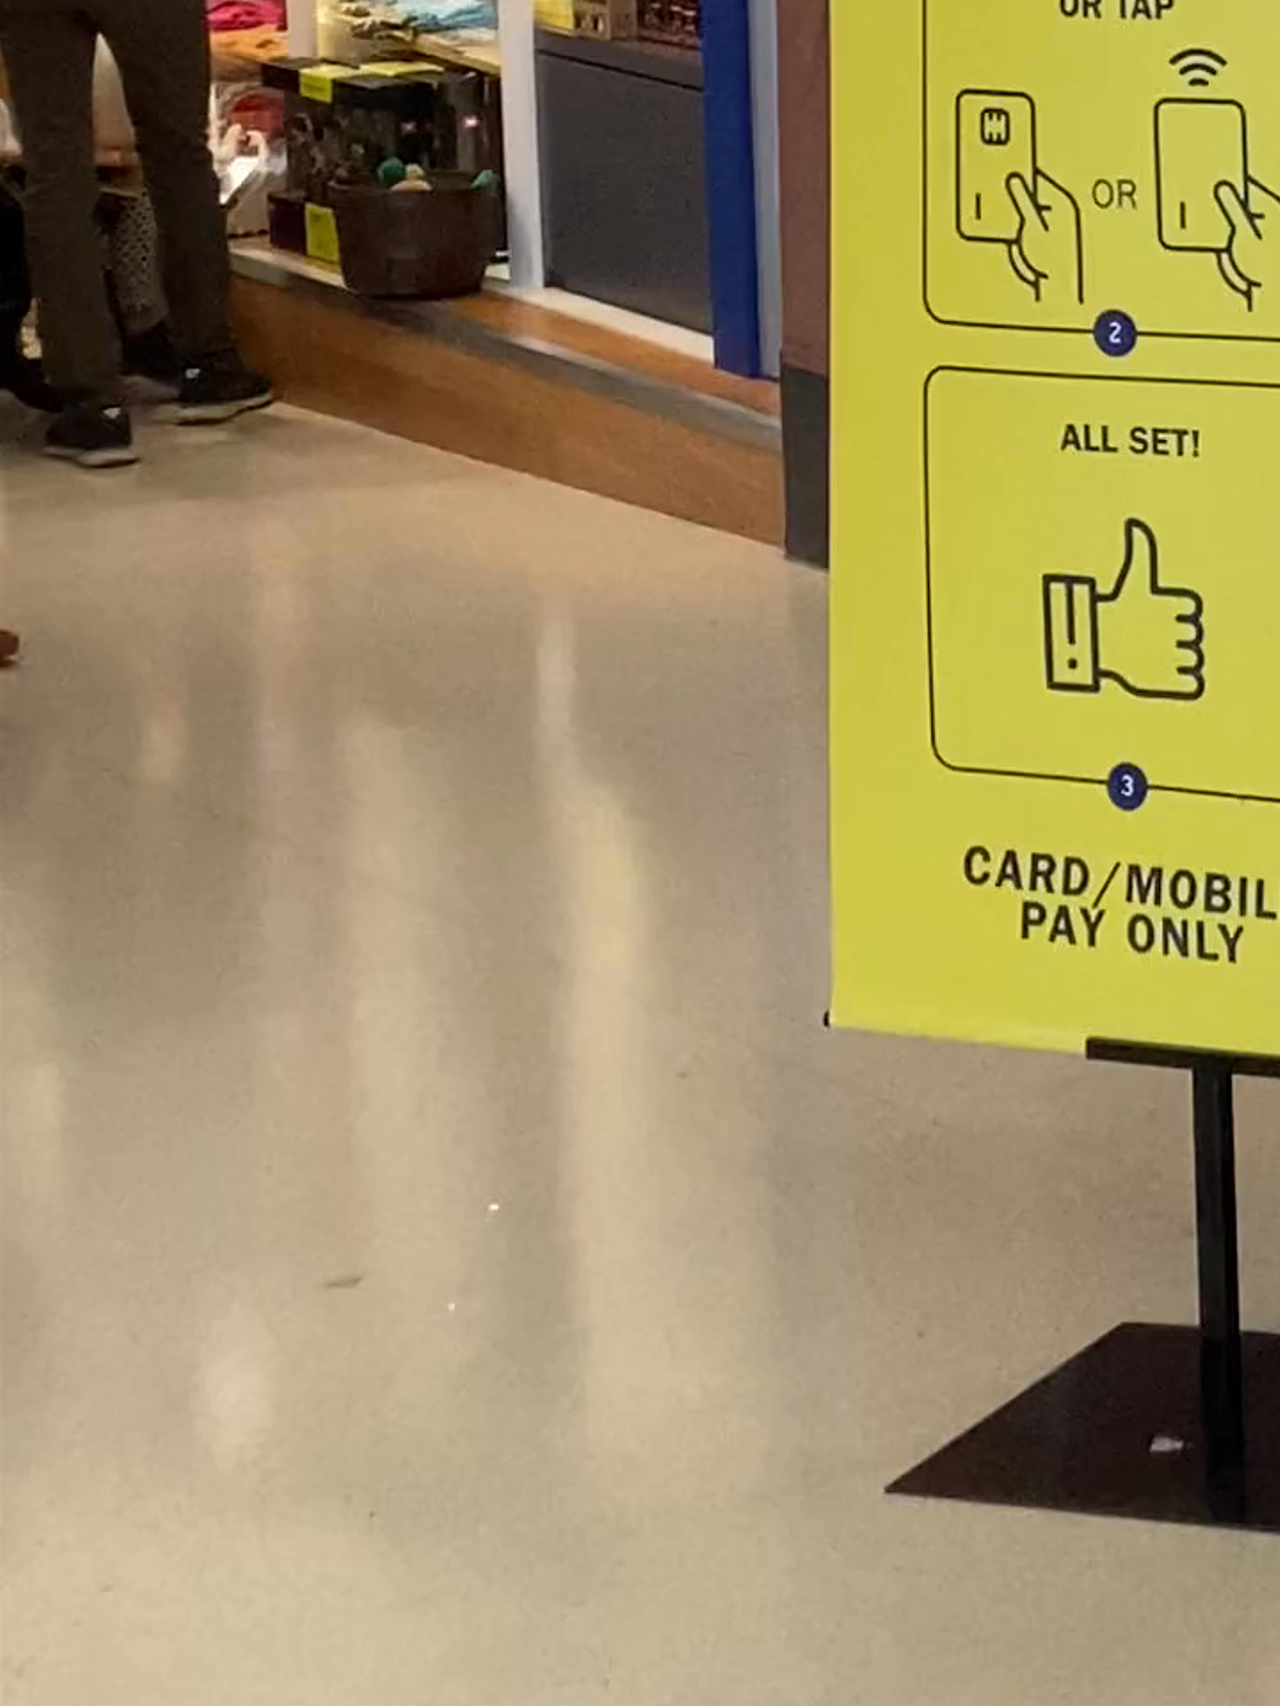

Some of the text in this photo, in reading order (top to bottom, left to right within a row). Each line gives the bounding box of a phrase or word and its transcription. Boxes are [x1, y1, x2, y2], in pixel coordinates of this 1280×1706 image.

[1091, 178, 1137, 211] OR
[1109, 321, 1122, 344] 2
[1060, 423, 1201, 458] ALL SET!
[1121, 774, 1134, 796] 3
[1020, 901, 1244, 964] PAY ONLY
